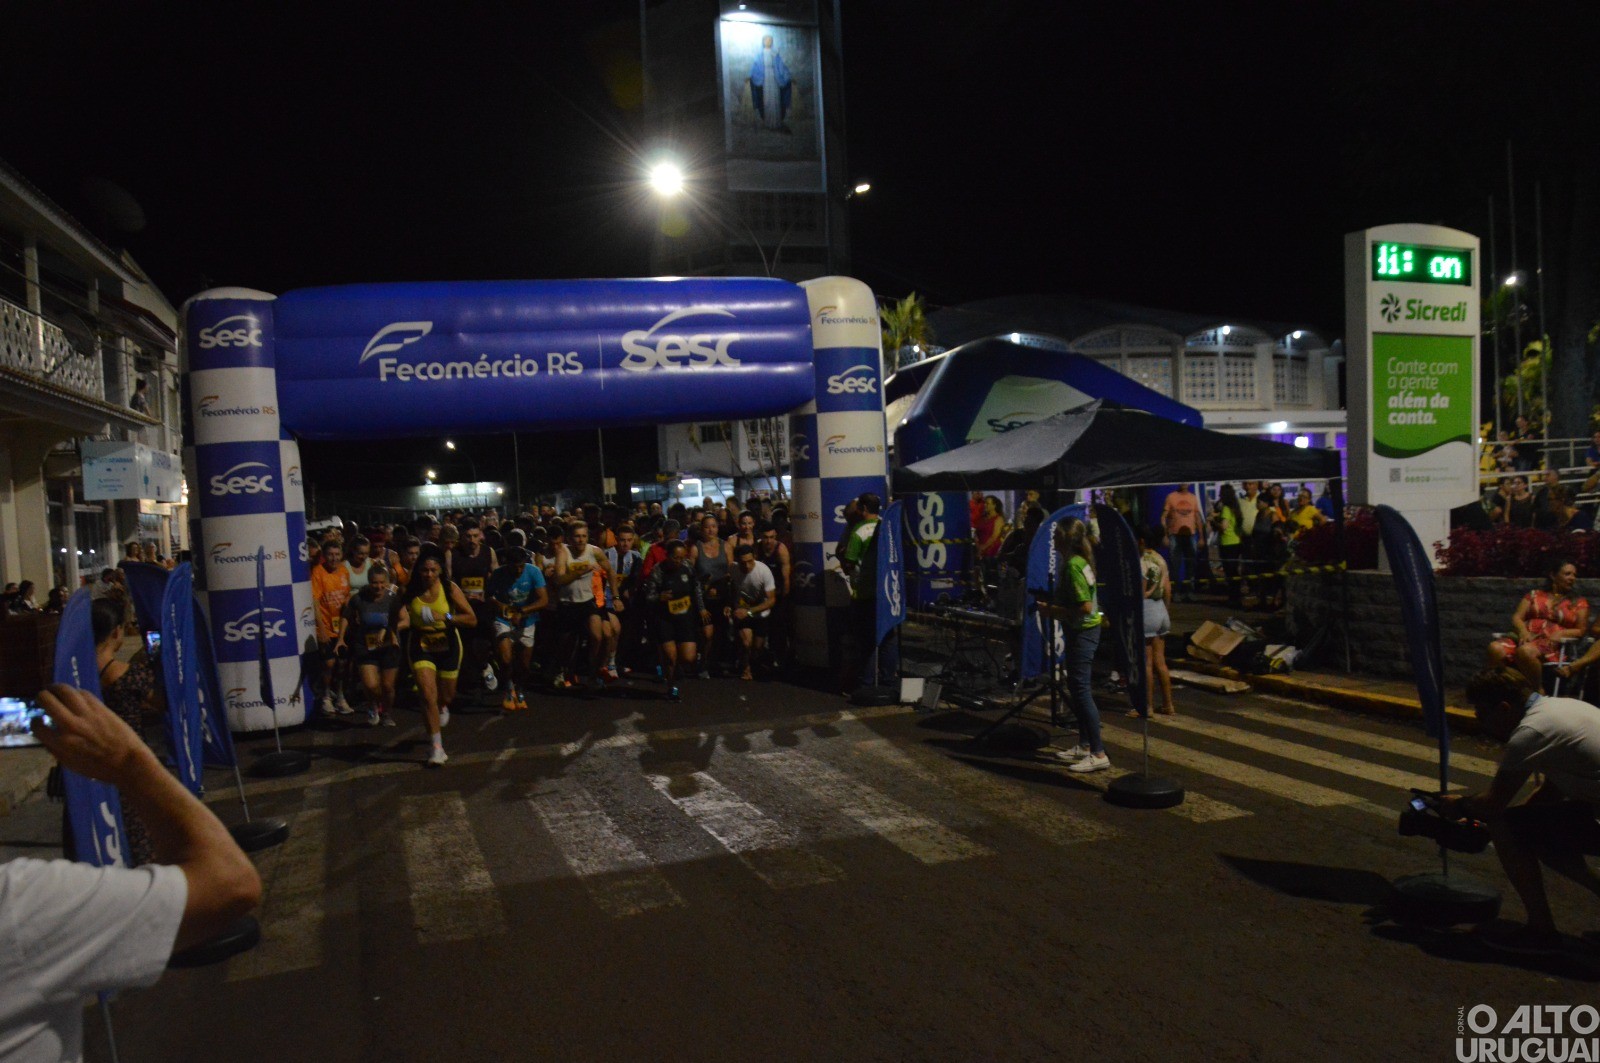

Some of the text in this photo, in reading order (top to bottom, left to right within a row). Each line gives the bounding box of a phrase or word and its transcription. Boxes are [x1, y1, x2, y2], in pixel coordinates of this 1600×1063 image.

[1404, 298, 1467, 322] Sicredi
[199, 321, 263, 349] Sesc
[619, 317, 741, 372] Sesc
[378, 351, 584, 382] Fecomércio RS
[1387, 357, 1458, 375] Conte com
[827, 369, 877, 394] Sesc
[1387, 376, 1439, 390] a gente
[202, 405, 260, 418] Fecomércio
[1388, 390, 1450, 409] além da
[1388, 410, 1437, 425] conta.
[210, 468, 274, 496] Sesc
